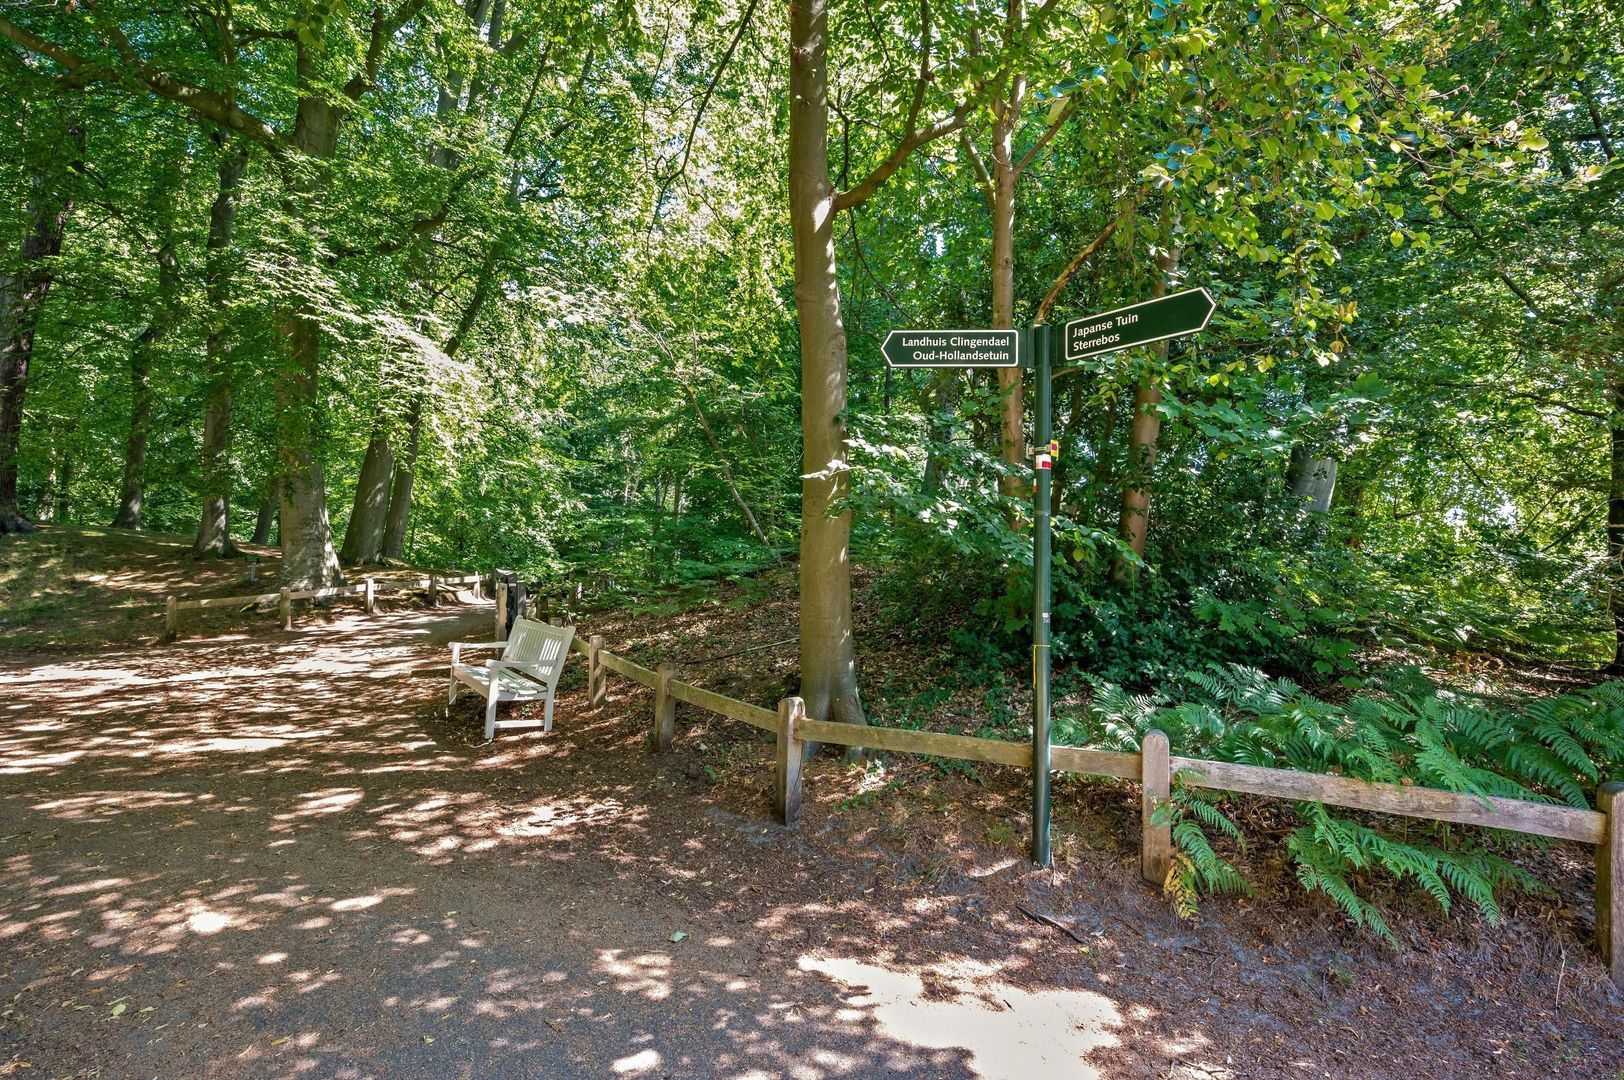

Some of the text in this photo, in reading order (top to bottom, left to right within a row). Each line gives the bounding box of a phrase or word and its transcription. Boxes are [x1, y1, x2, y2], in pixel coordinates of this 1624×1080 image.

[1072, 313, 1138, 338] Japanse Tuin
[902, 336, 1010, 349] Landhuis Clingendael
[1073, 333, 1120, 352] Sterrebos
[912, 350, 1009, 361] Oud-Hollandsetuin
